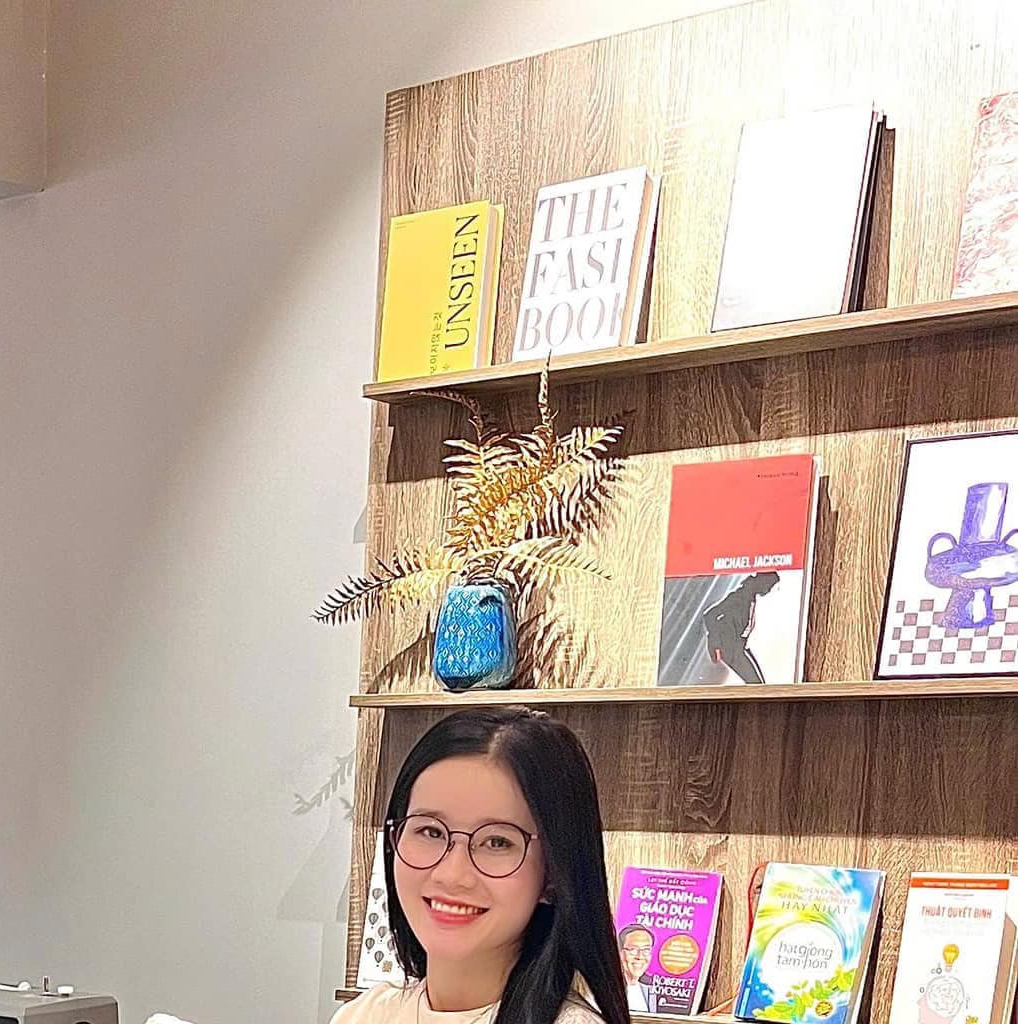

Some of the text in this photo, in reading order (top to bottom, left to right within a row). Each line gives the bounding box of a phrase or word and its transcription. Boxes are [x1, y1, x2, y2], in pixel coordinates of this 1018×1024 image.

[537, 183, 628, 243] THE
[444, 213, 481, 349] UNSEEN
[713, 553, 793, 570] MICHAEL JACKSON
[631, 885, 656, 900] SỨC
[639, 900, 695, 918] GIÁO DỤC
[655, 915, 694, 931] CHÍNH
